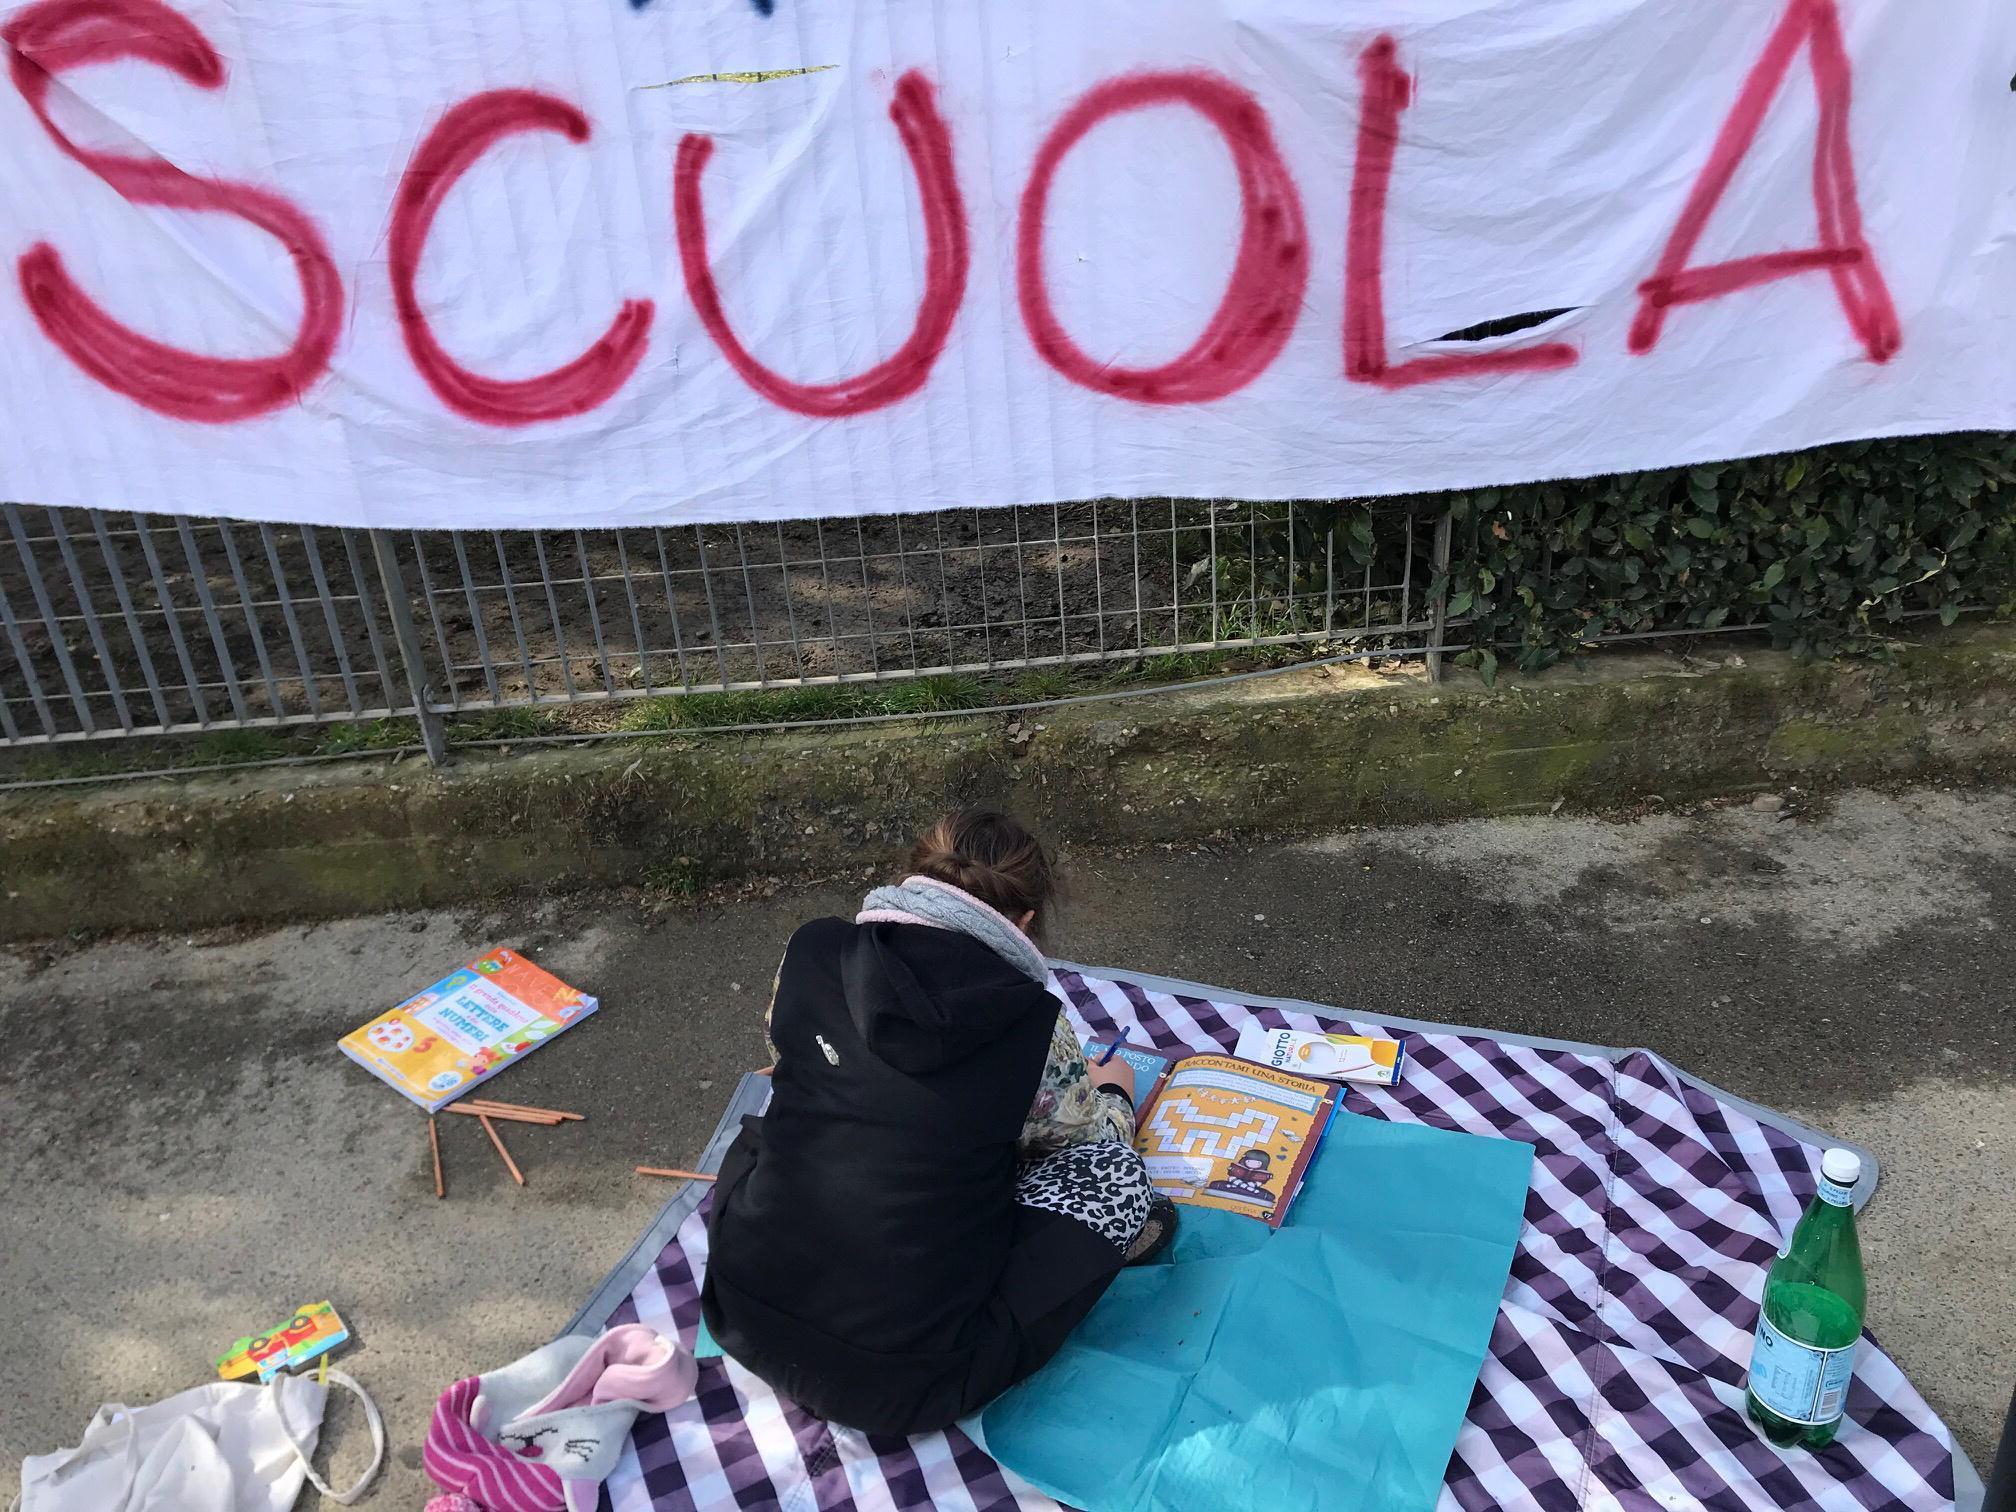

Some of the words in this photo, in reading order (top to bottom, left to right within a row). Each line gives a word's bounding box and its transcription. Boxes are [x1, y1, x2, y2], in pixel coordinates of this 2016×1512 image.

[3, 0, 1900, 424] SCUOLA
[438, 1008, 489, 1042] NUMERI
[456, 996, 509, 1032] LETTERE
[1123, 1050, 1155, 1065] POSTO
[1271, 1032, 1291, 1067] GIOTTO
[1184, 1058, 1249, 1074] RACCONTAMI
[1252, 1069, 1275, 1081] UNA
[1278, 1077, 1317, 1093] STORIA
